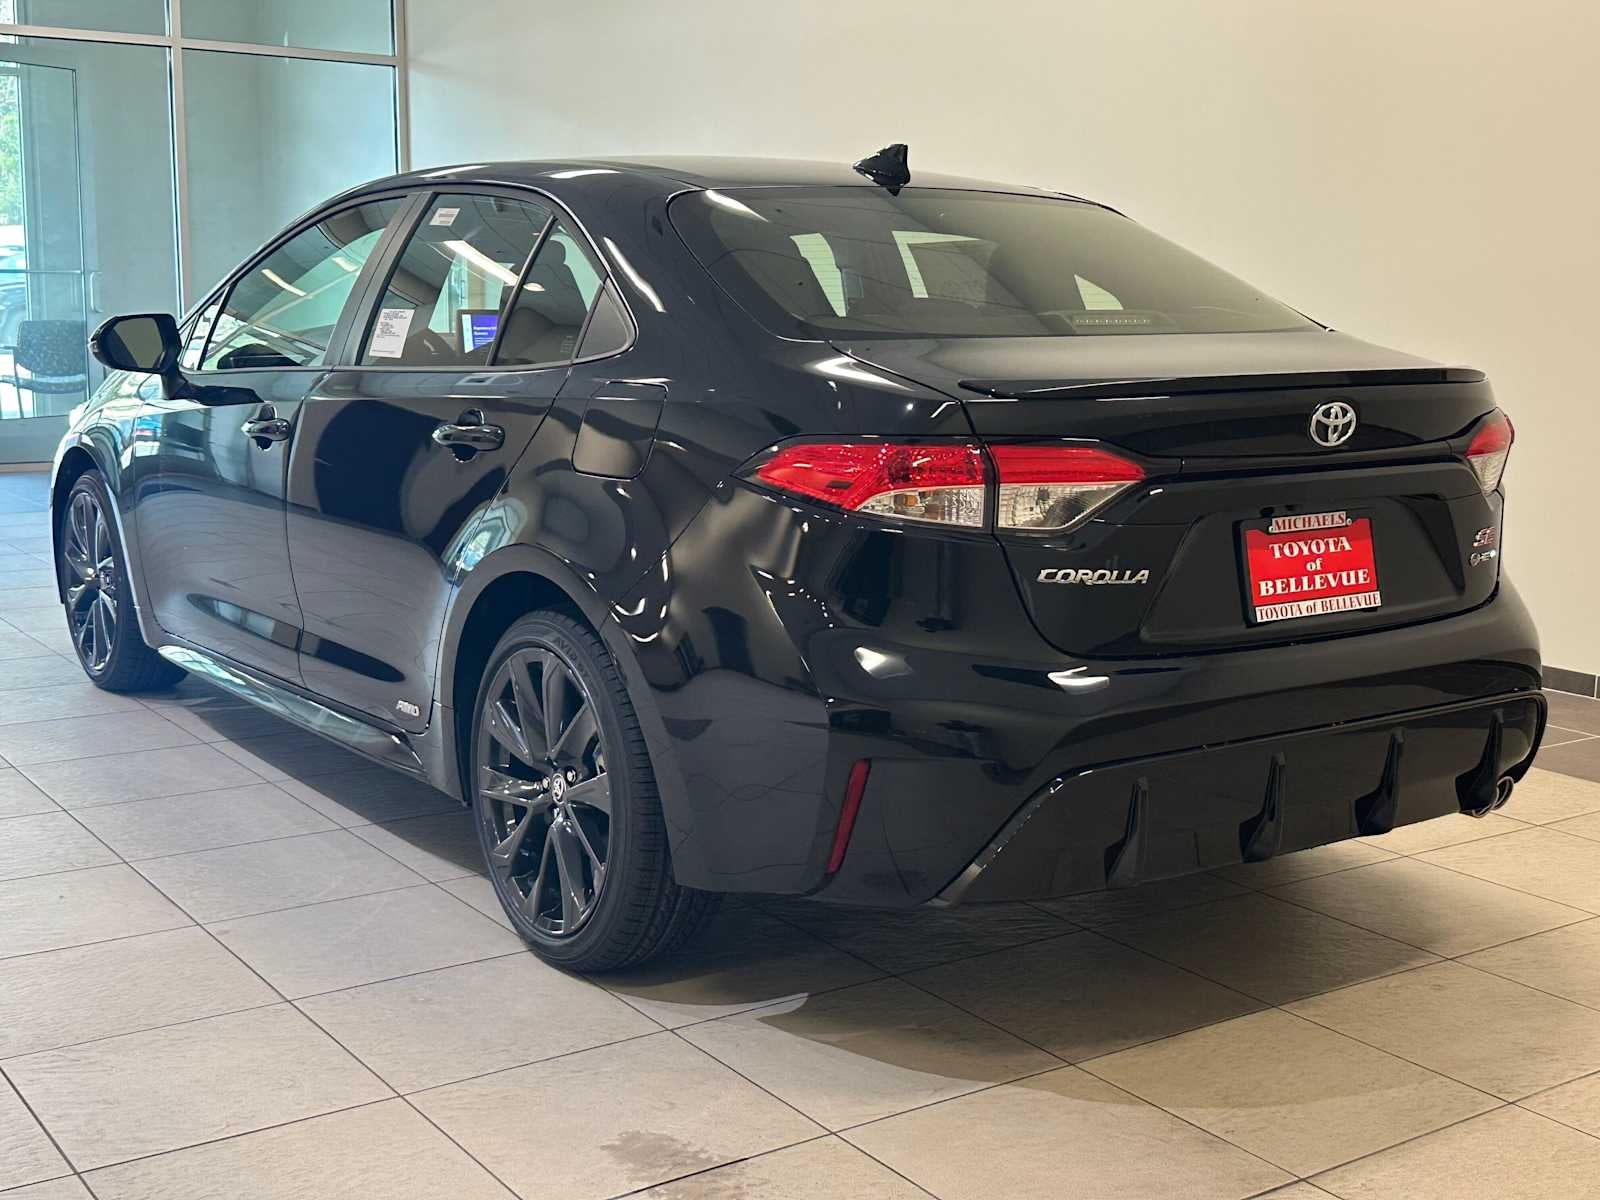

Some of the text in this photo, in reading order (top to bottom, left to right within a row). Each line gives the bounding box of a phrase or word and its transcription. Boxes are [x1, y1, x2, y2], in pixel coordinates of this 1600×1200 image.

[1274, 513, 1345, 531] MICHAELS
[1269, 537, 1352, 559] TOYOTA
[1306, 558, 1322, 572] of
[1037, 569, 1150, 585] COROLLA
[1258, 569, 1370, 596] BELLEVUE
[1258, 593, 1380, 620] TOYOTA of BELLEVUE
